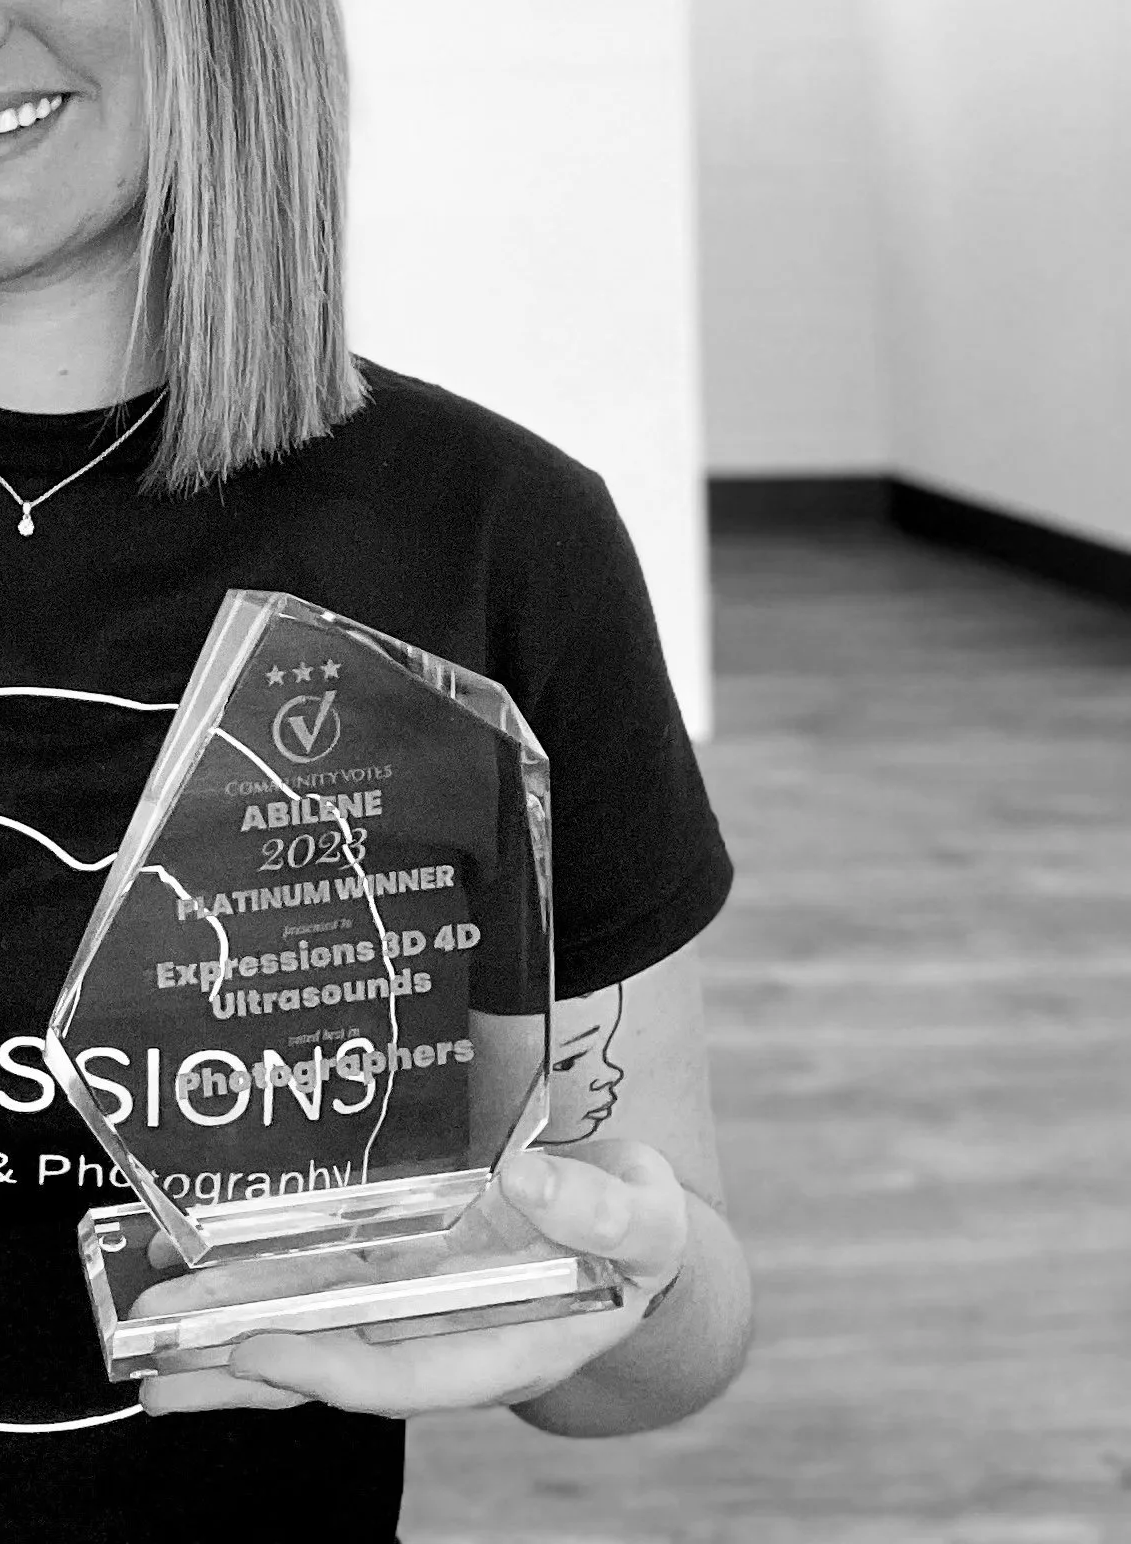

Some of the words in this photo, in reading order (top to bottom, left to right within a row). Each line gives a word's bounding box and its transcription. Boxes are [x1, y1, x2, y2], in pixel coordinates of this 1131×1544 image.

[240, 789, 384, 833] ABILENE
[257, 827, 369, 872] 2023
[177, 879, 331, 921] PLATINUM
[333, 864, 455, 901] WINNER
[157, 939, 376, 993] Expressions
[383, 931, 427, 959] 3D
[434, 923, 482, 952] 4D
[212, 968, 433, 1020] Ultrasounds
[178, 1039, 476, 1101] Photographers
[38, 1153, 352, 1206] Phoography
